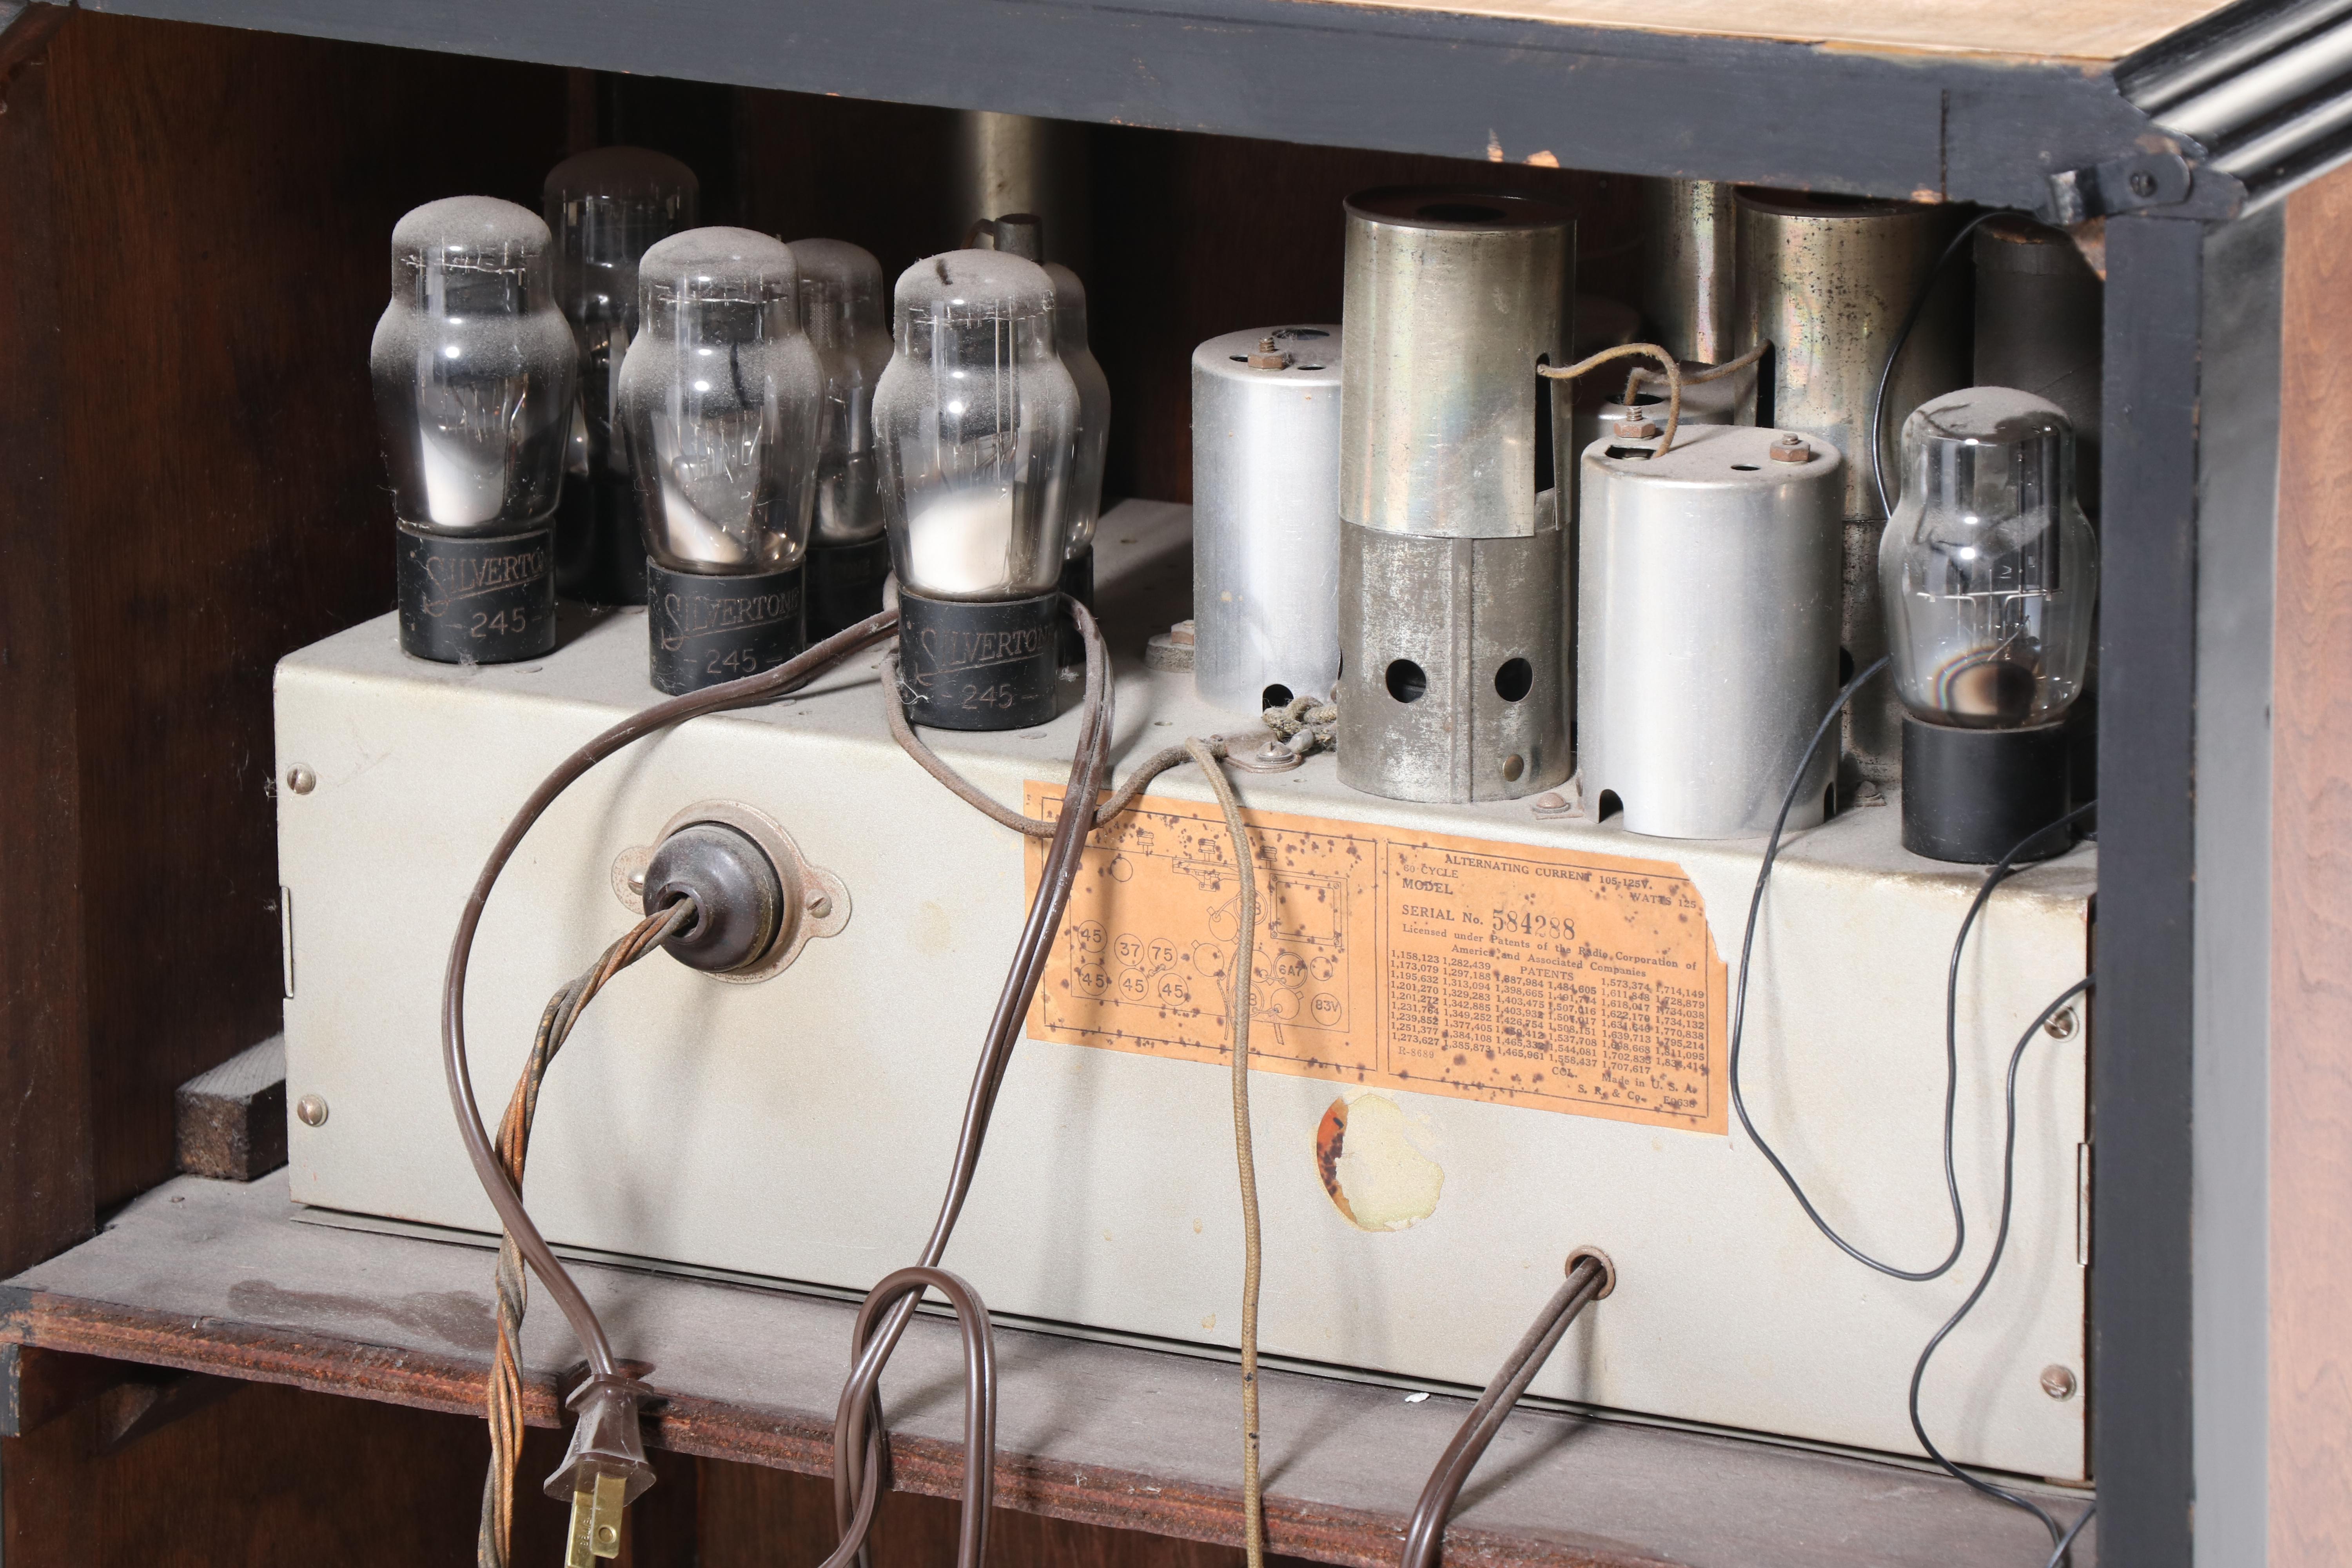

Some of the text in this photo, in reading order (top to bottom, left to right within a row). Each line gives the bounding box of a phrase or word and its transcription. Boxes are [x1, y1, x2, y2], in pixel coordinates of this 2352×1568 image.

[1421, 866, 1458, 878] CYCLE
[1445, 855, 1652, 889] ALTERNATING CURRENT 105-125V.
[1402, 878, 1453, 895] MODEL
[1630, 892, 1696, 908] WATTS 125
[1402, 905, 1575, 940] SERIAL No. 584288
[1081, 928, 1102, 943] 45
[1120, 942, 1140, 957] 37
[1152, 946, 1172, 961] 75
[1403, 924, 1697, 970] Licensed under Patents of the Radio Corporation of
[1392, 950, 1491, 969] 1,158,123 1,282,439
[1452, 944, 1646, 977] America and Associated Companies
[1279, 965, 1305, 976] 6A7
[1520, 966, 1574, 980] PATENTS
[1082, 973, 1104, 987] 45
[1123, 978, 1143, 993] 45
[1391, 960, 1704, 1009] 1,173,079 1,297,188 1,387,984 1,484,605 1,611,848 1,728,879
[1601, 978, 1704, 998] 1,573,374 1,714,149
[1162, 983, 1183, 998] 45
[1391, 971, 1438, 984] 1,195,632
[1443, 978, 1490, 991] 1,313,094
[1496, 985, 1543, 998] 1,398,665
[1602, 998, 1650, 1011] 1,618,017
[1656, 1006, 1704, 1019] 1,734,038
[1316, 999, 1339, 1012] 83V
[1391, 981, 1704, 1029] 1,201,270 1,329,283 1,403,475 1,507,016 1,622,170 1,734,132
[1392, 991, 1438, 1004] 1,201,272
[1443, 999, 1490, 1011] 1,342,885
[1496, 1005, 1543, 1018] 1,403,932
[1549, 1012, 1596, 1025] 1,507,017
[1655, 1026, 1704, 1040] 1,770,838
[1392, 1002, 1704, 1050] 1,231,764 1,349,252 1,426,754 1,508,151 1,639,713 1,795,214
[1392, 1012, 1438, 1025] 1,239,852
[1445, 1019, 1492, 1032] 1,377,405
[1549, 1033, 1597, 1046] 1,537,708
[1656, 1047, 1704, 1061] 1,811,095
[1392, 1022, 1438, 1034] 1,251,377
[1445, 1029, 1492, 1042] 1,384,108
[1550, 1044, 1596, 1056] 1,544,081
[1603, 1051, 1651, 1064] 1,702,833
[1657, 1058, 1705, 1071] 1,834,414
[1392, 1033, 1650, 1074] 1,273,627 1,385,873 1,465,961 1,558,437 1,707,617
[1398, 1046, 1434, 1058] R-8689
[1552, 1067, 1577, 1078] COL.
[1602, 1073, 1697, 1094] Made in U. S. A.
[1578, 1084, 1588, 1094] S.
[1612, 1089, 1621, 1098] &
[1627, 1091, 1647, 1102] Co.
